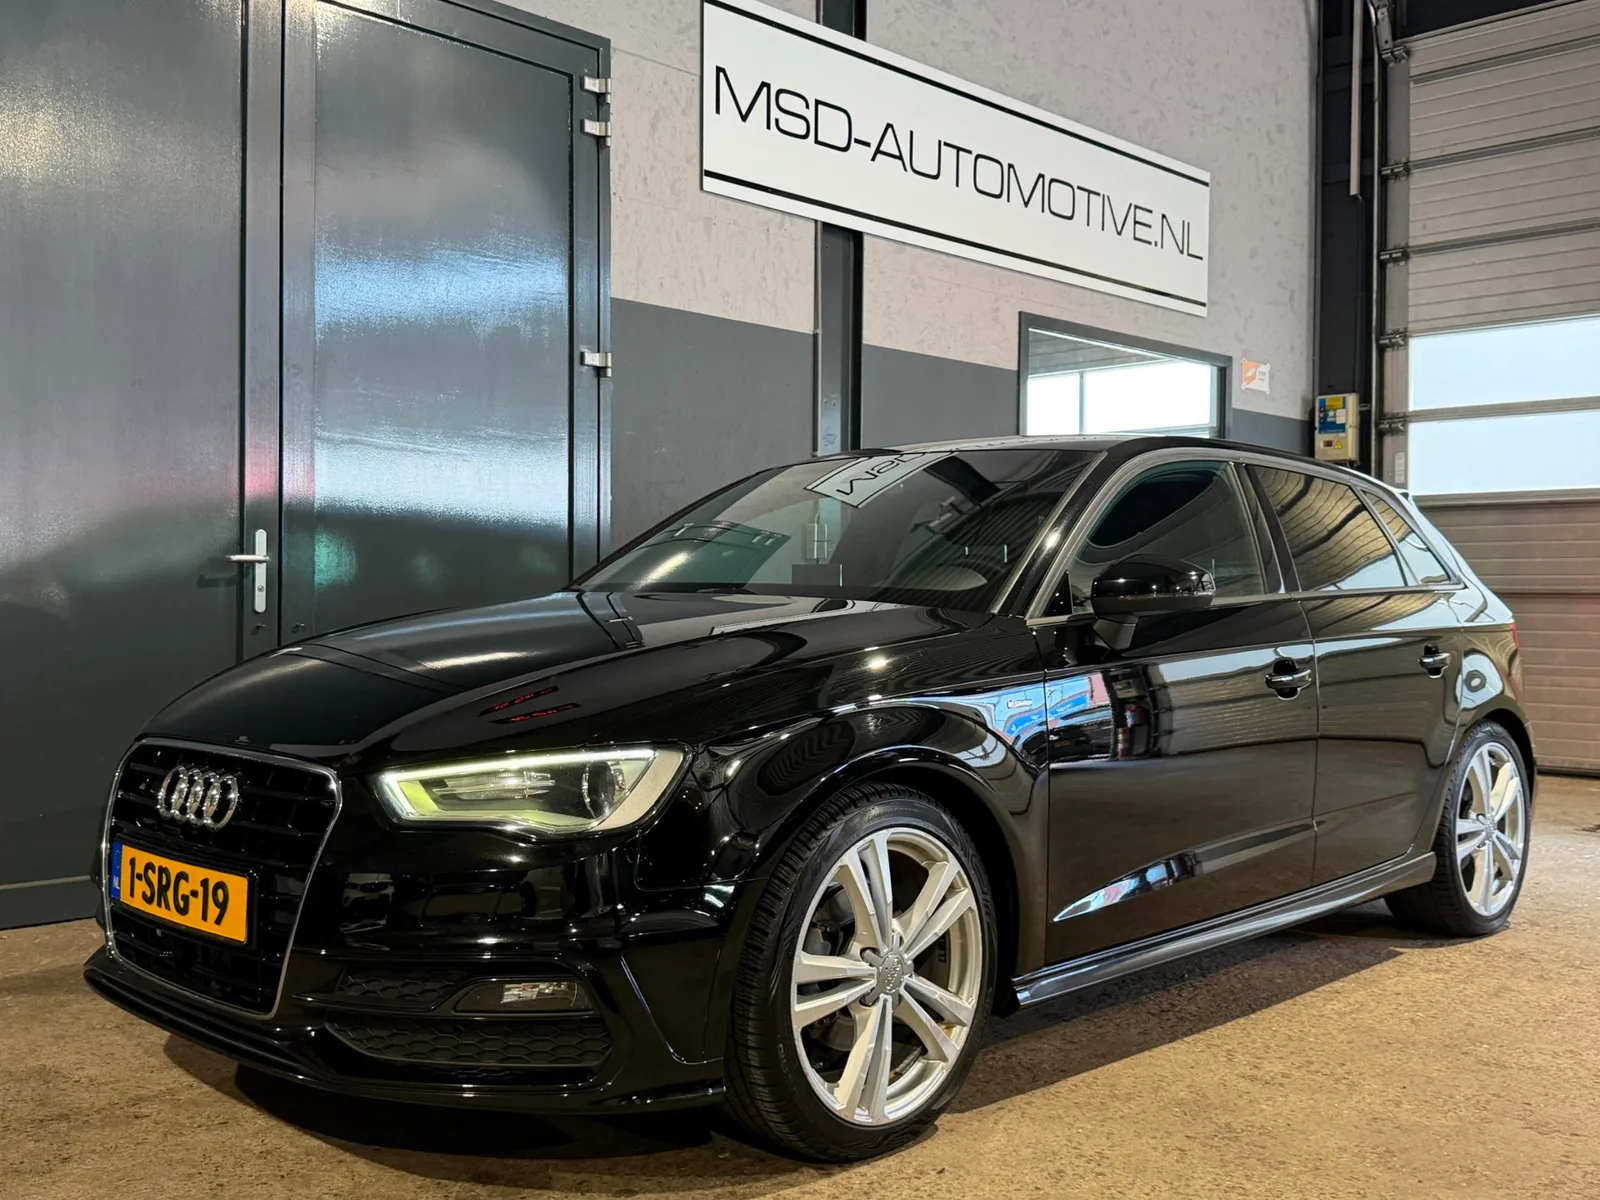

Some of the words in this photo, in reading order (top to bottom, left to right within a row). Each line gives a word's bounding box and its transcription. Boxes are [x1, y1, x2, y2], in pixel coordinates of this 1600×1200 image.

[715, 65, 1203, 260] MSD-AUTOMOTIVE.NL
[113, 876, 120, 890] NL
[129, 857, 229, 926] 1-SRG-19
